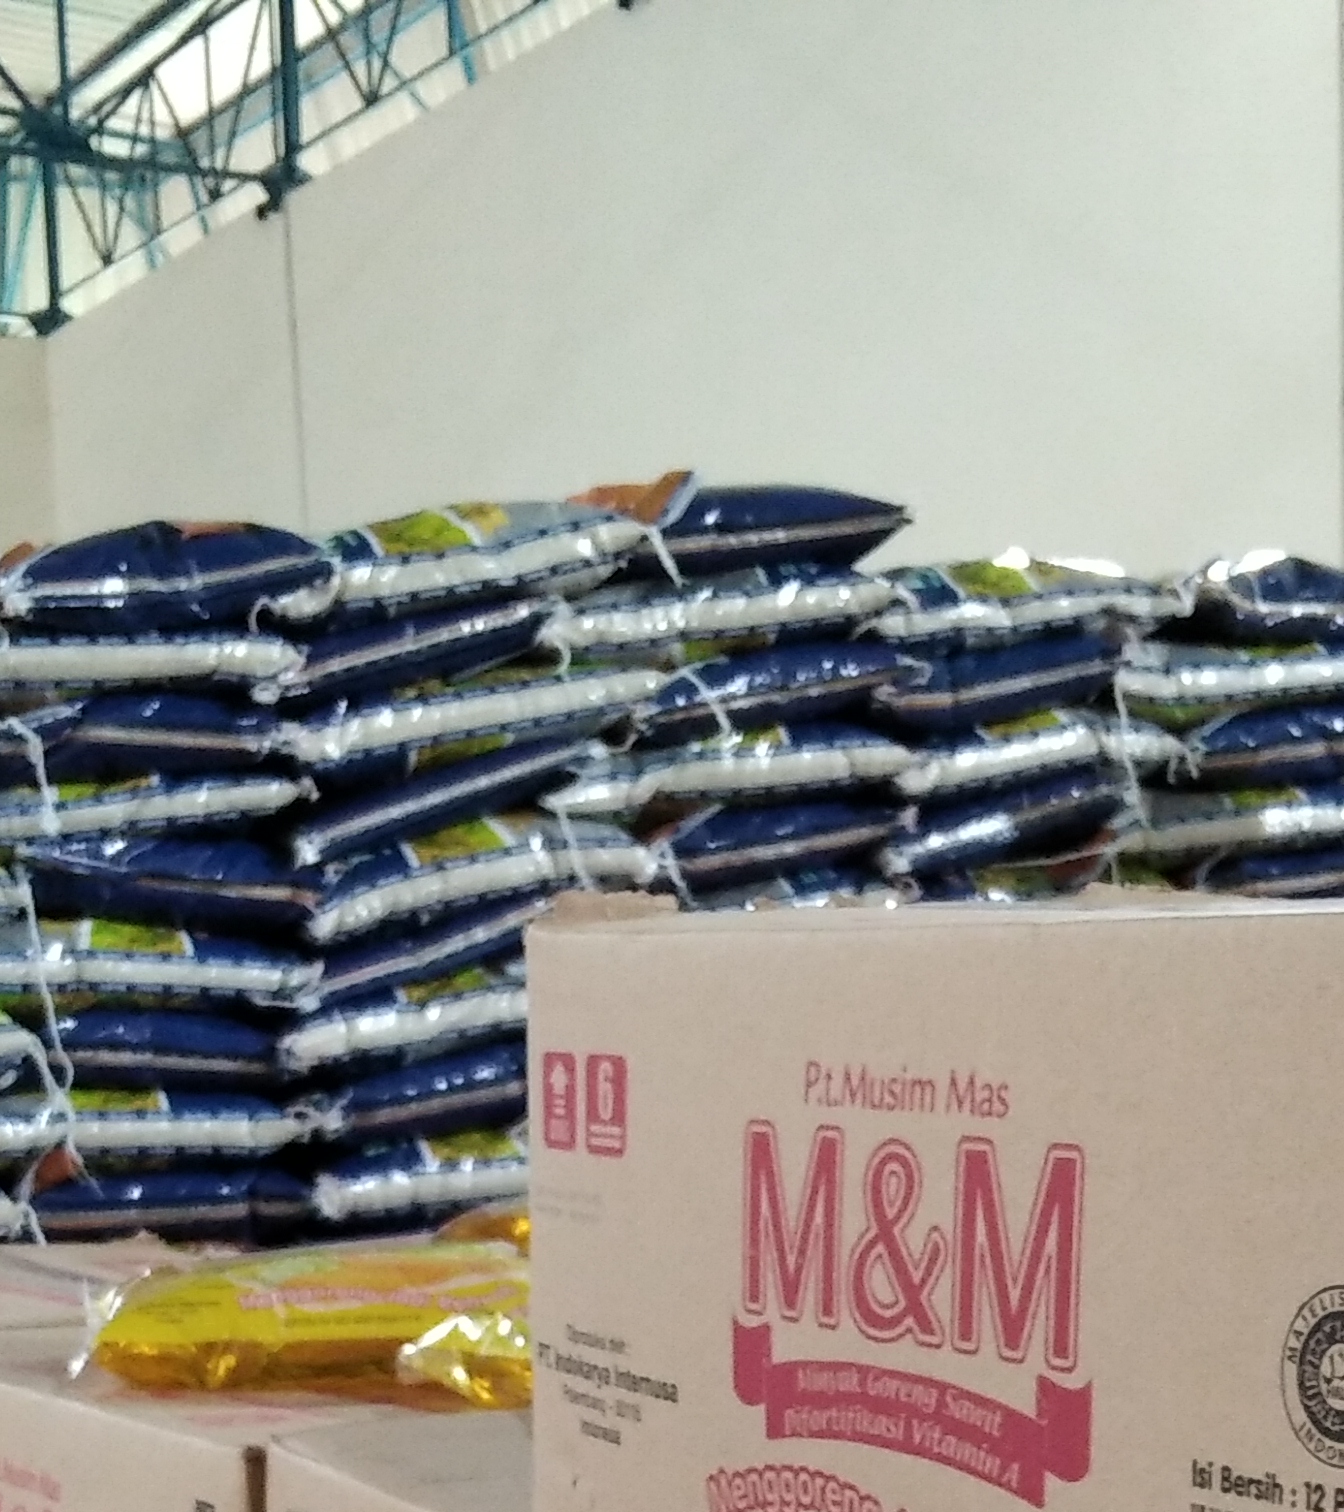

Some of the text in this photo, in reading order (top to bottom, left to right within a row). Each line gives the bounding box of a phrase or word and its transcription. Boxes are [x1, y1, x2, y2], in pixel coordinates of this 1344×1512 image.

[945, 1068, 1010, 1118] Mas
[743, 1119, 1086, 1373] M&M
[1003, 1462, 1020, 1489] A
[1191, 1458, 1214, 1490] Isi
[1220, 1465, 1284, 1506] Bersih
